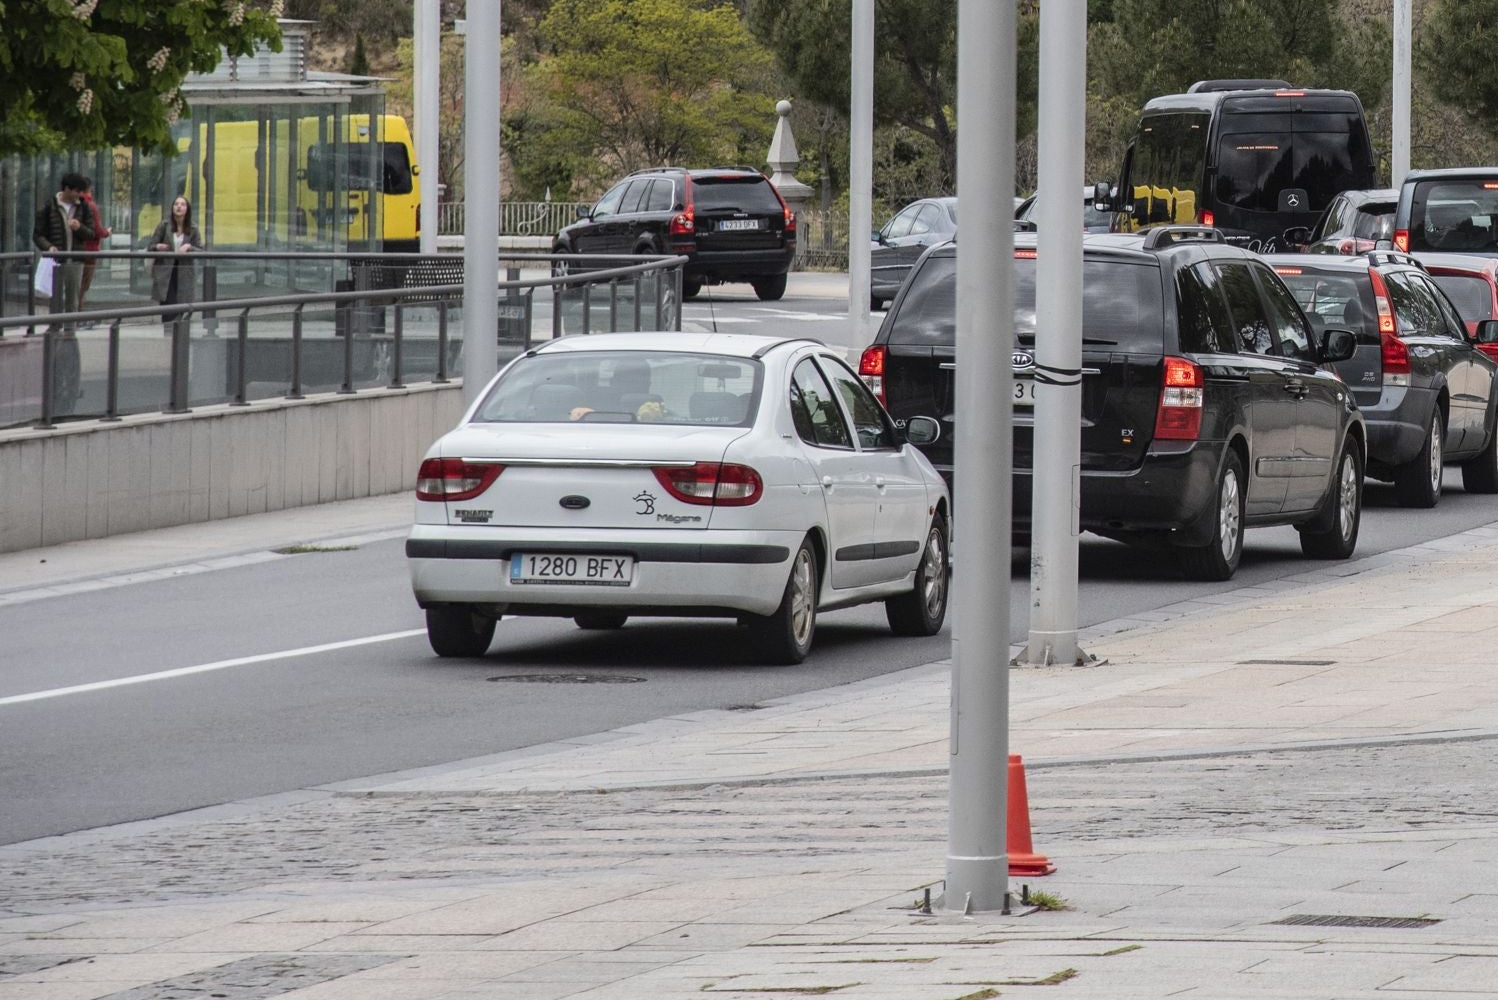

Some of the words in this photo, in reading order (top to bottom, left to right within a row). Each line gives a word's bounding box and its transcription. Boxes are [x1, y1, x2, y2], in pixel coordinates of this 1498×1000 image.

[1121, 429, 1134, 437] EX
[529, 556, 577, 577] 1280
[587, 557, 625, 579] BFX
